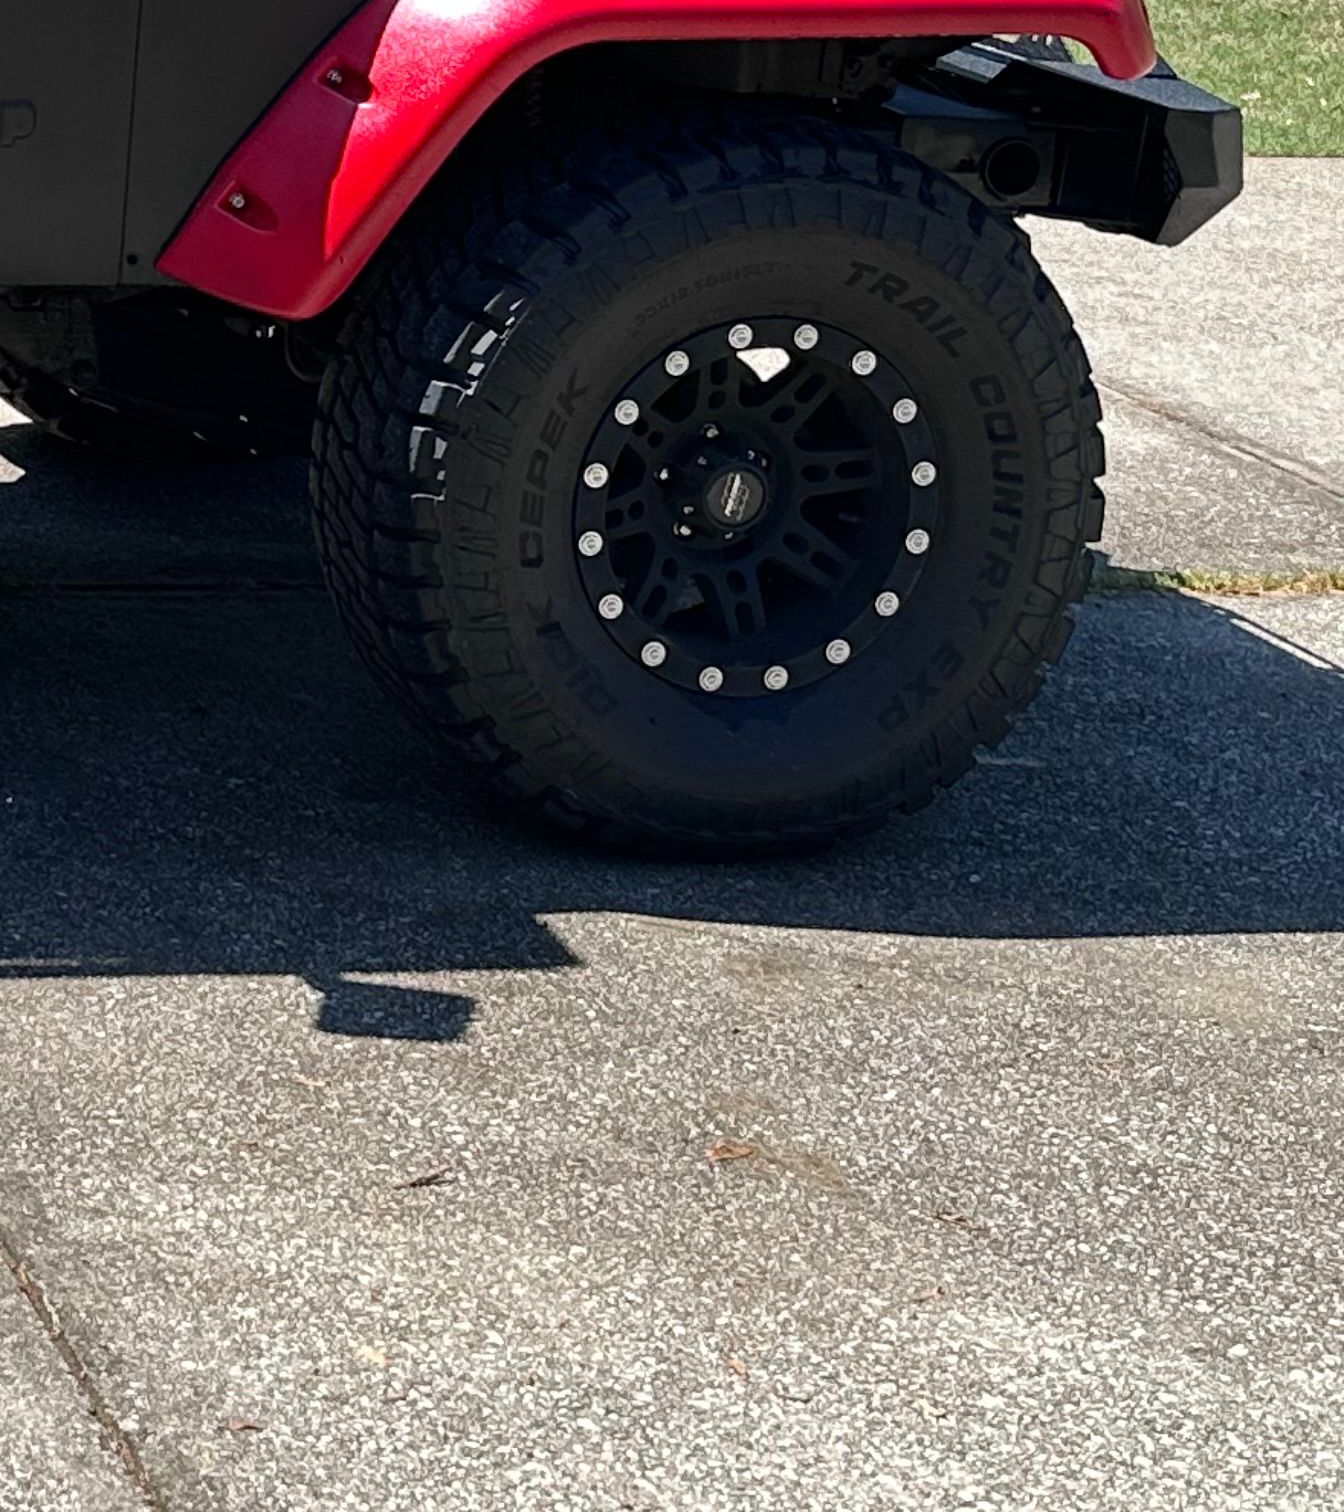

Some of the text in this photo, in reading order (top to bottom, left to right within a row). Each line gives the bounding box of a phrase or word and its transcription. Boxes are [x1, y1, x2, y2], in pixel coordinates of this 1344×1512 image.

[519, 367, 591, 568] CEPEK
[844, 260, 968, 359] TRAIL
[968, 373, 1025, 628] COUNTRY
